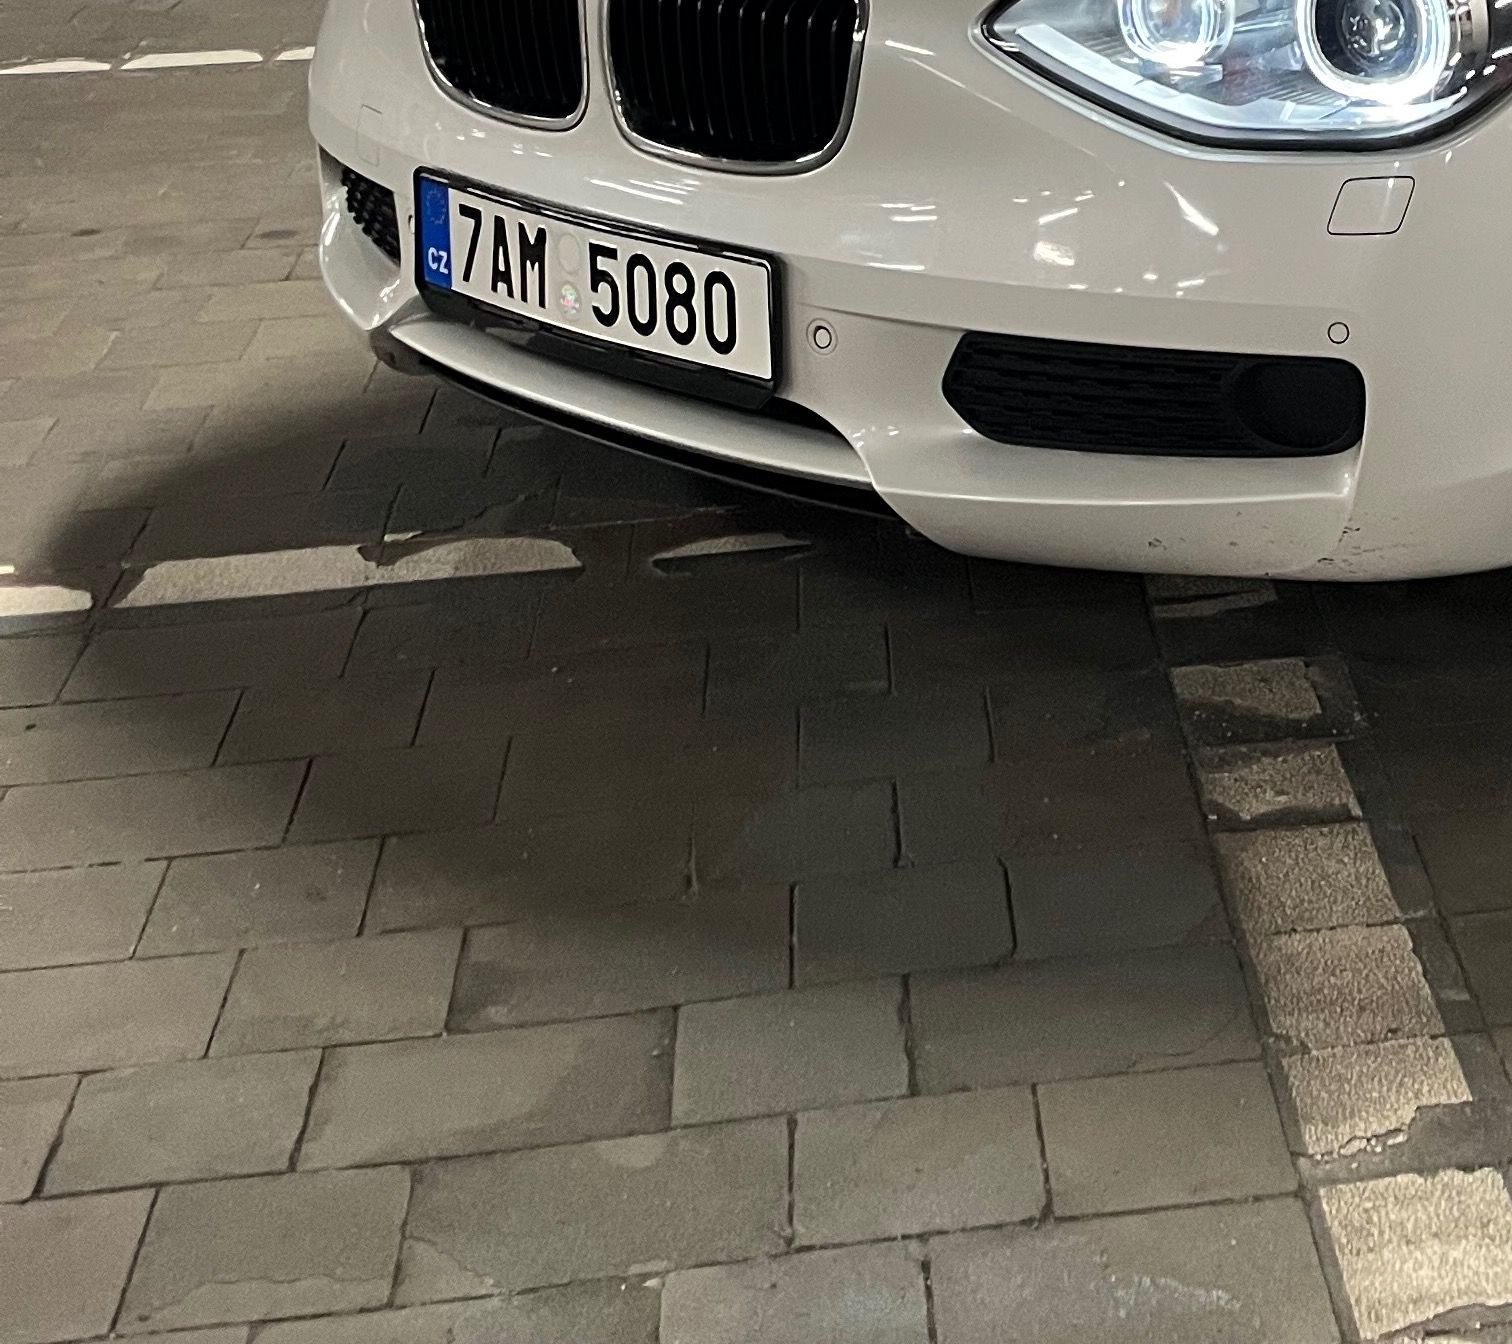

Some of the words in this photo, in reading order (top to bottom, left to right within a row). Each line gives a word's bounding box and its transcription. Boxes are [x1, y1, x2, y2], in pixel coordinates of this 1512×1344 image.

[428, 247, 449, 275] CZ
[458, 203, 547, 310] 7AM
[588, 241, 737, 355] 5080
